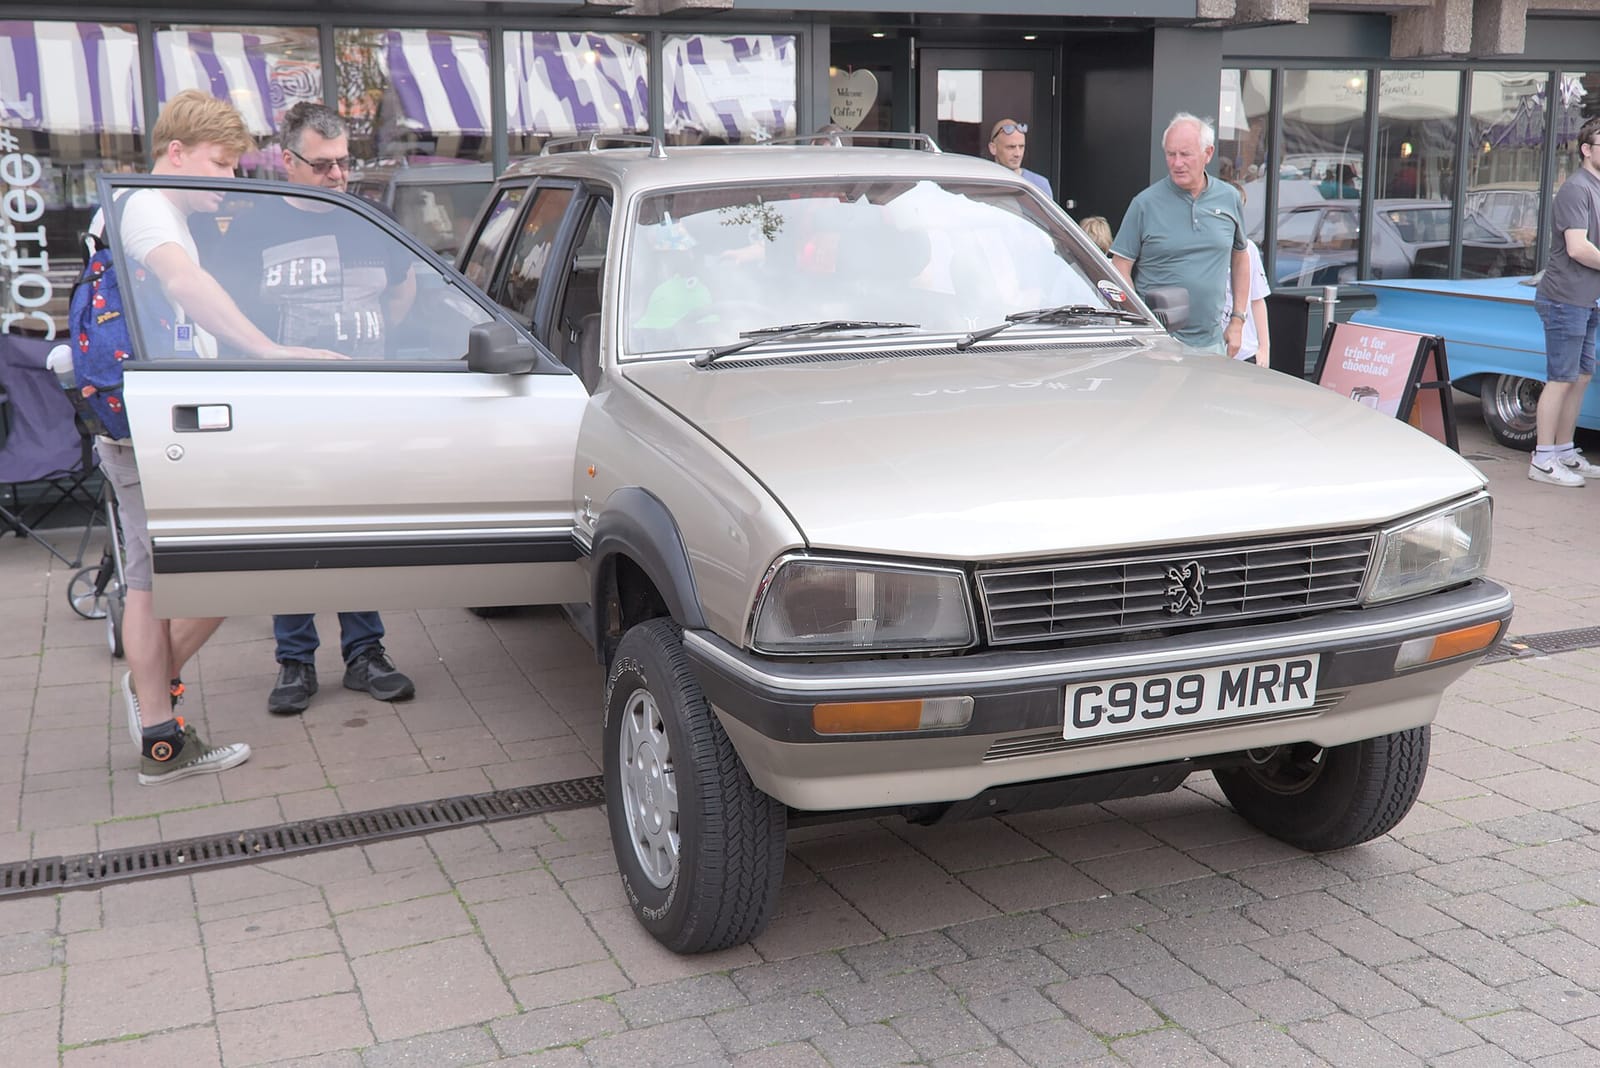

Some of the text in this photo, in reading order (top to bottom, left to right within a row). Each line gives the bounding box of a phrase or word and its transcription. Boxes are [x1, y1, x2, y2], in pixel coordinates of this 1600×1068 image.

[266, 258, 328, 286] BER
[334, 311, 380, 340] LIN
[1344, 346, 1371, 361] triple
[1371, 336, 1386, 349] for
[1342, 360, 1389, 376] chocolate
[1073, 659, 1313, 729] G999 MRR
